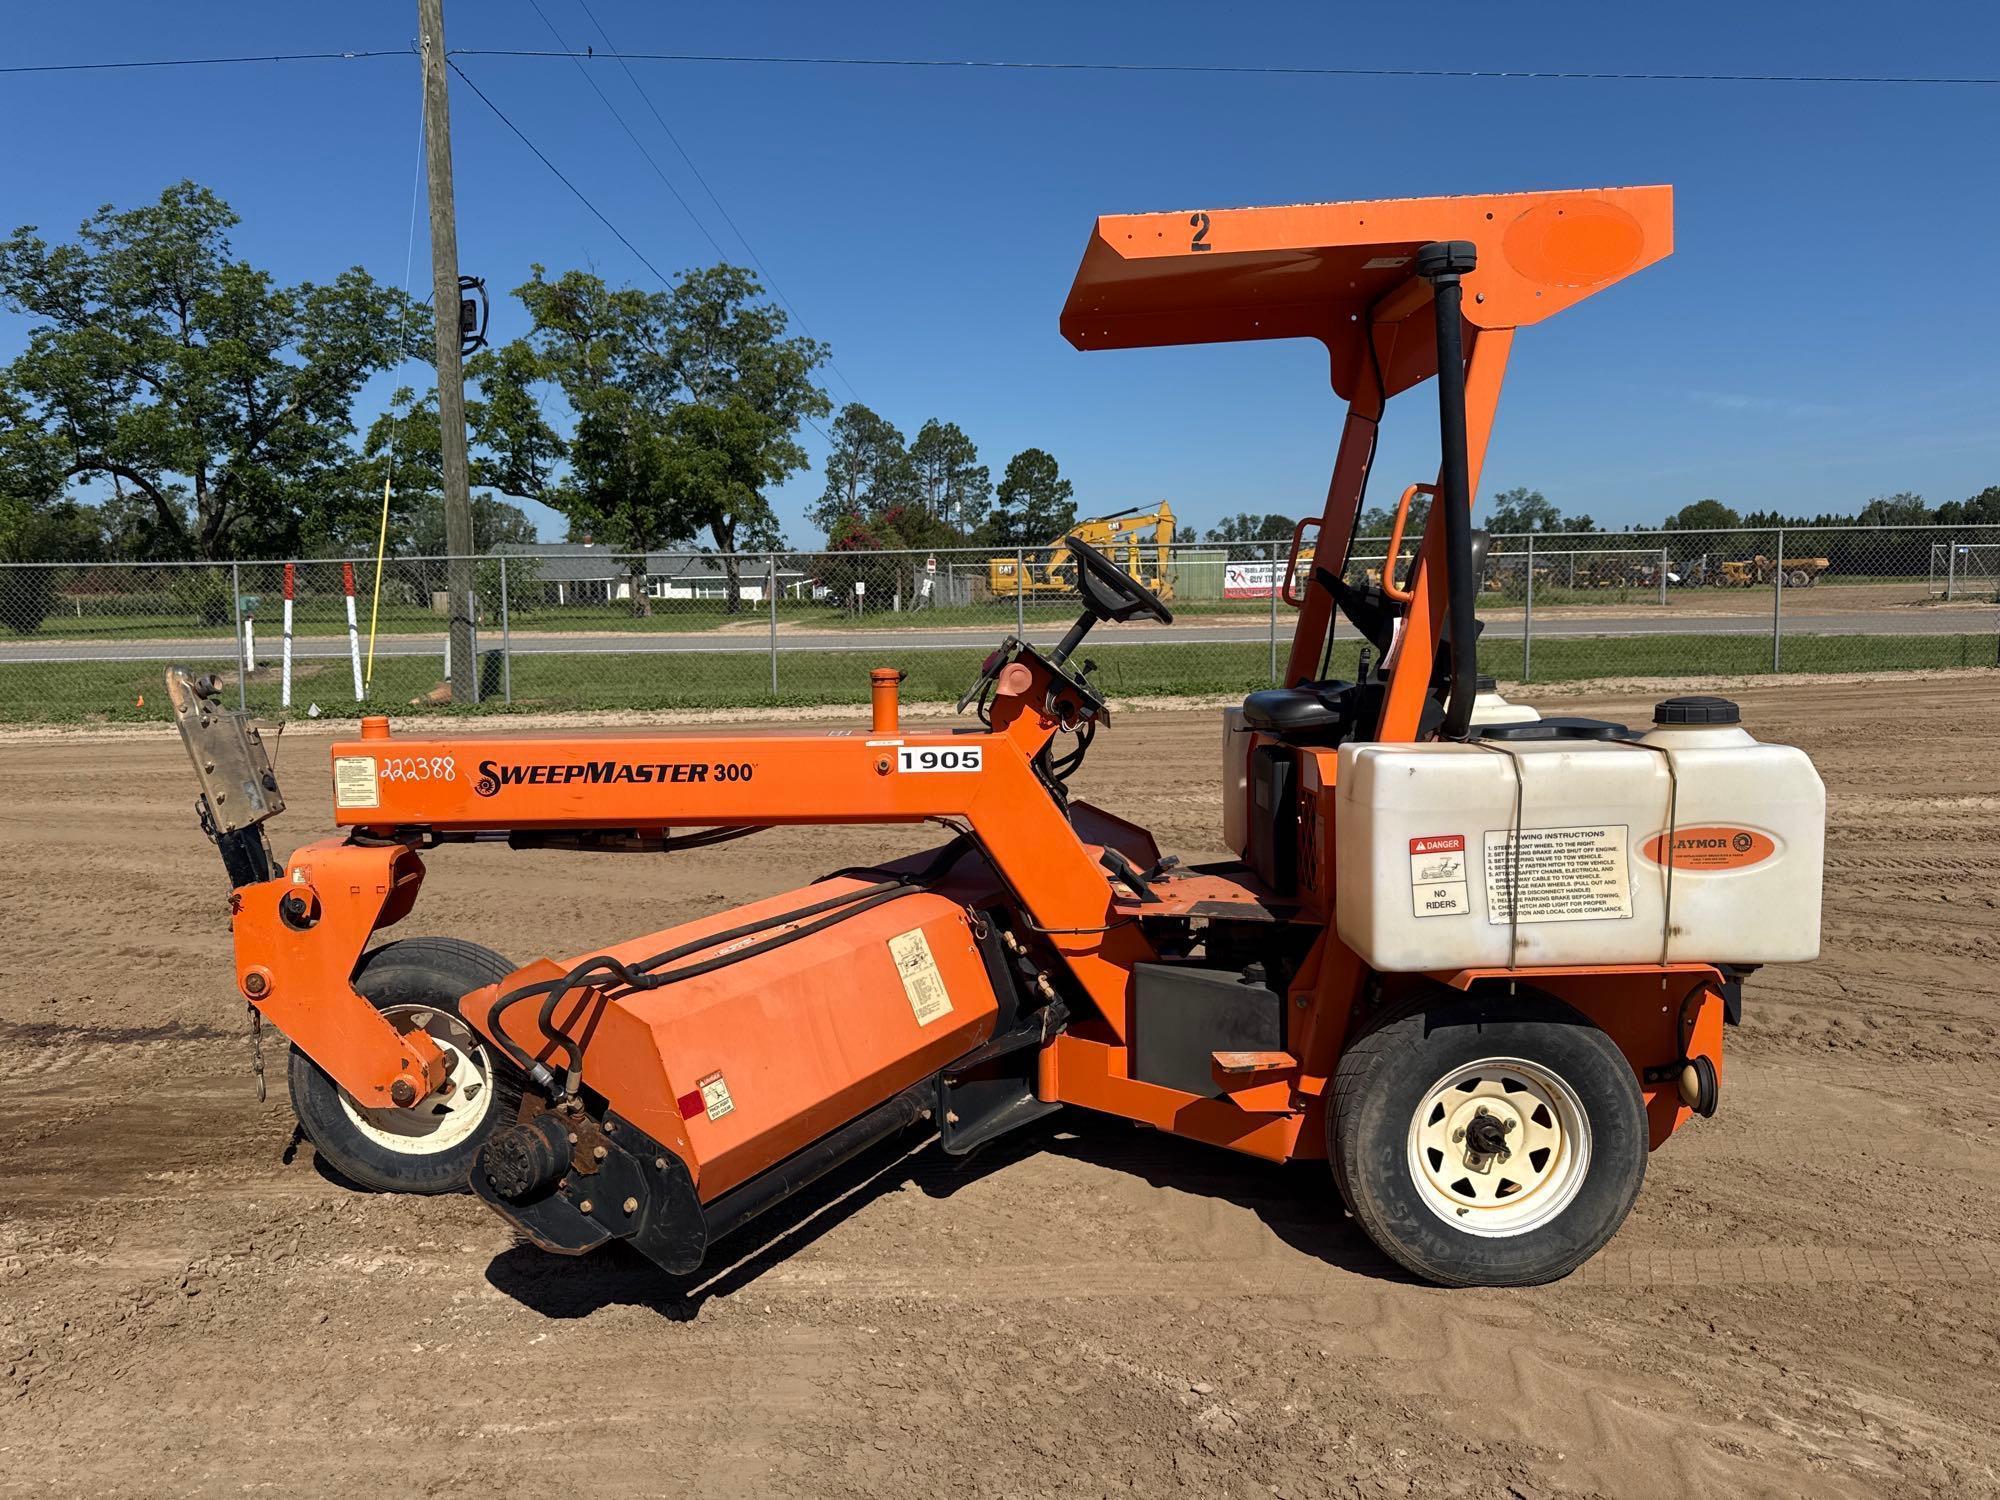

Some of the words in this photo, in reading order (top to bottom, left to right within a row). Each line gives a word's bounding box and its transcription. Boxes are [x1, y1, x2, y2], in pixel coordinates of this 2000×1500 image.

[1190, 213, 1211, 251] 2
[1108, 522, 1119, 530] CAT
[998, 565, 1012, 574] CAT
[901, 751, 980, 769] 1905
[380, 756, 456, 782] 222388
[474, 760, 709, 797] SWEEPMASTER
[714, 763, 753, 782] 300
[1544, 831, 1605, 839] INSTRUCTIONS
[1427, 840, 1459, 849] DANGER
[1434, 889, 1447, 897] NO
[1426, 900, 1456, 909] RIDERS
